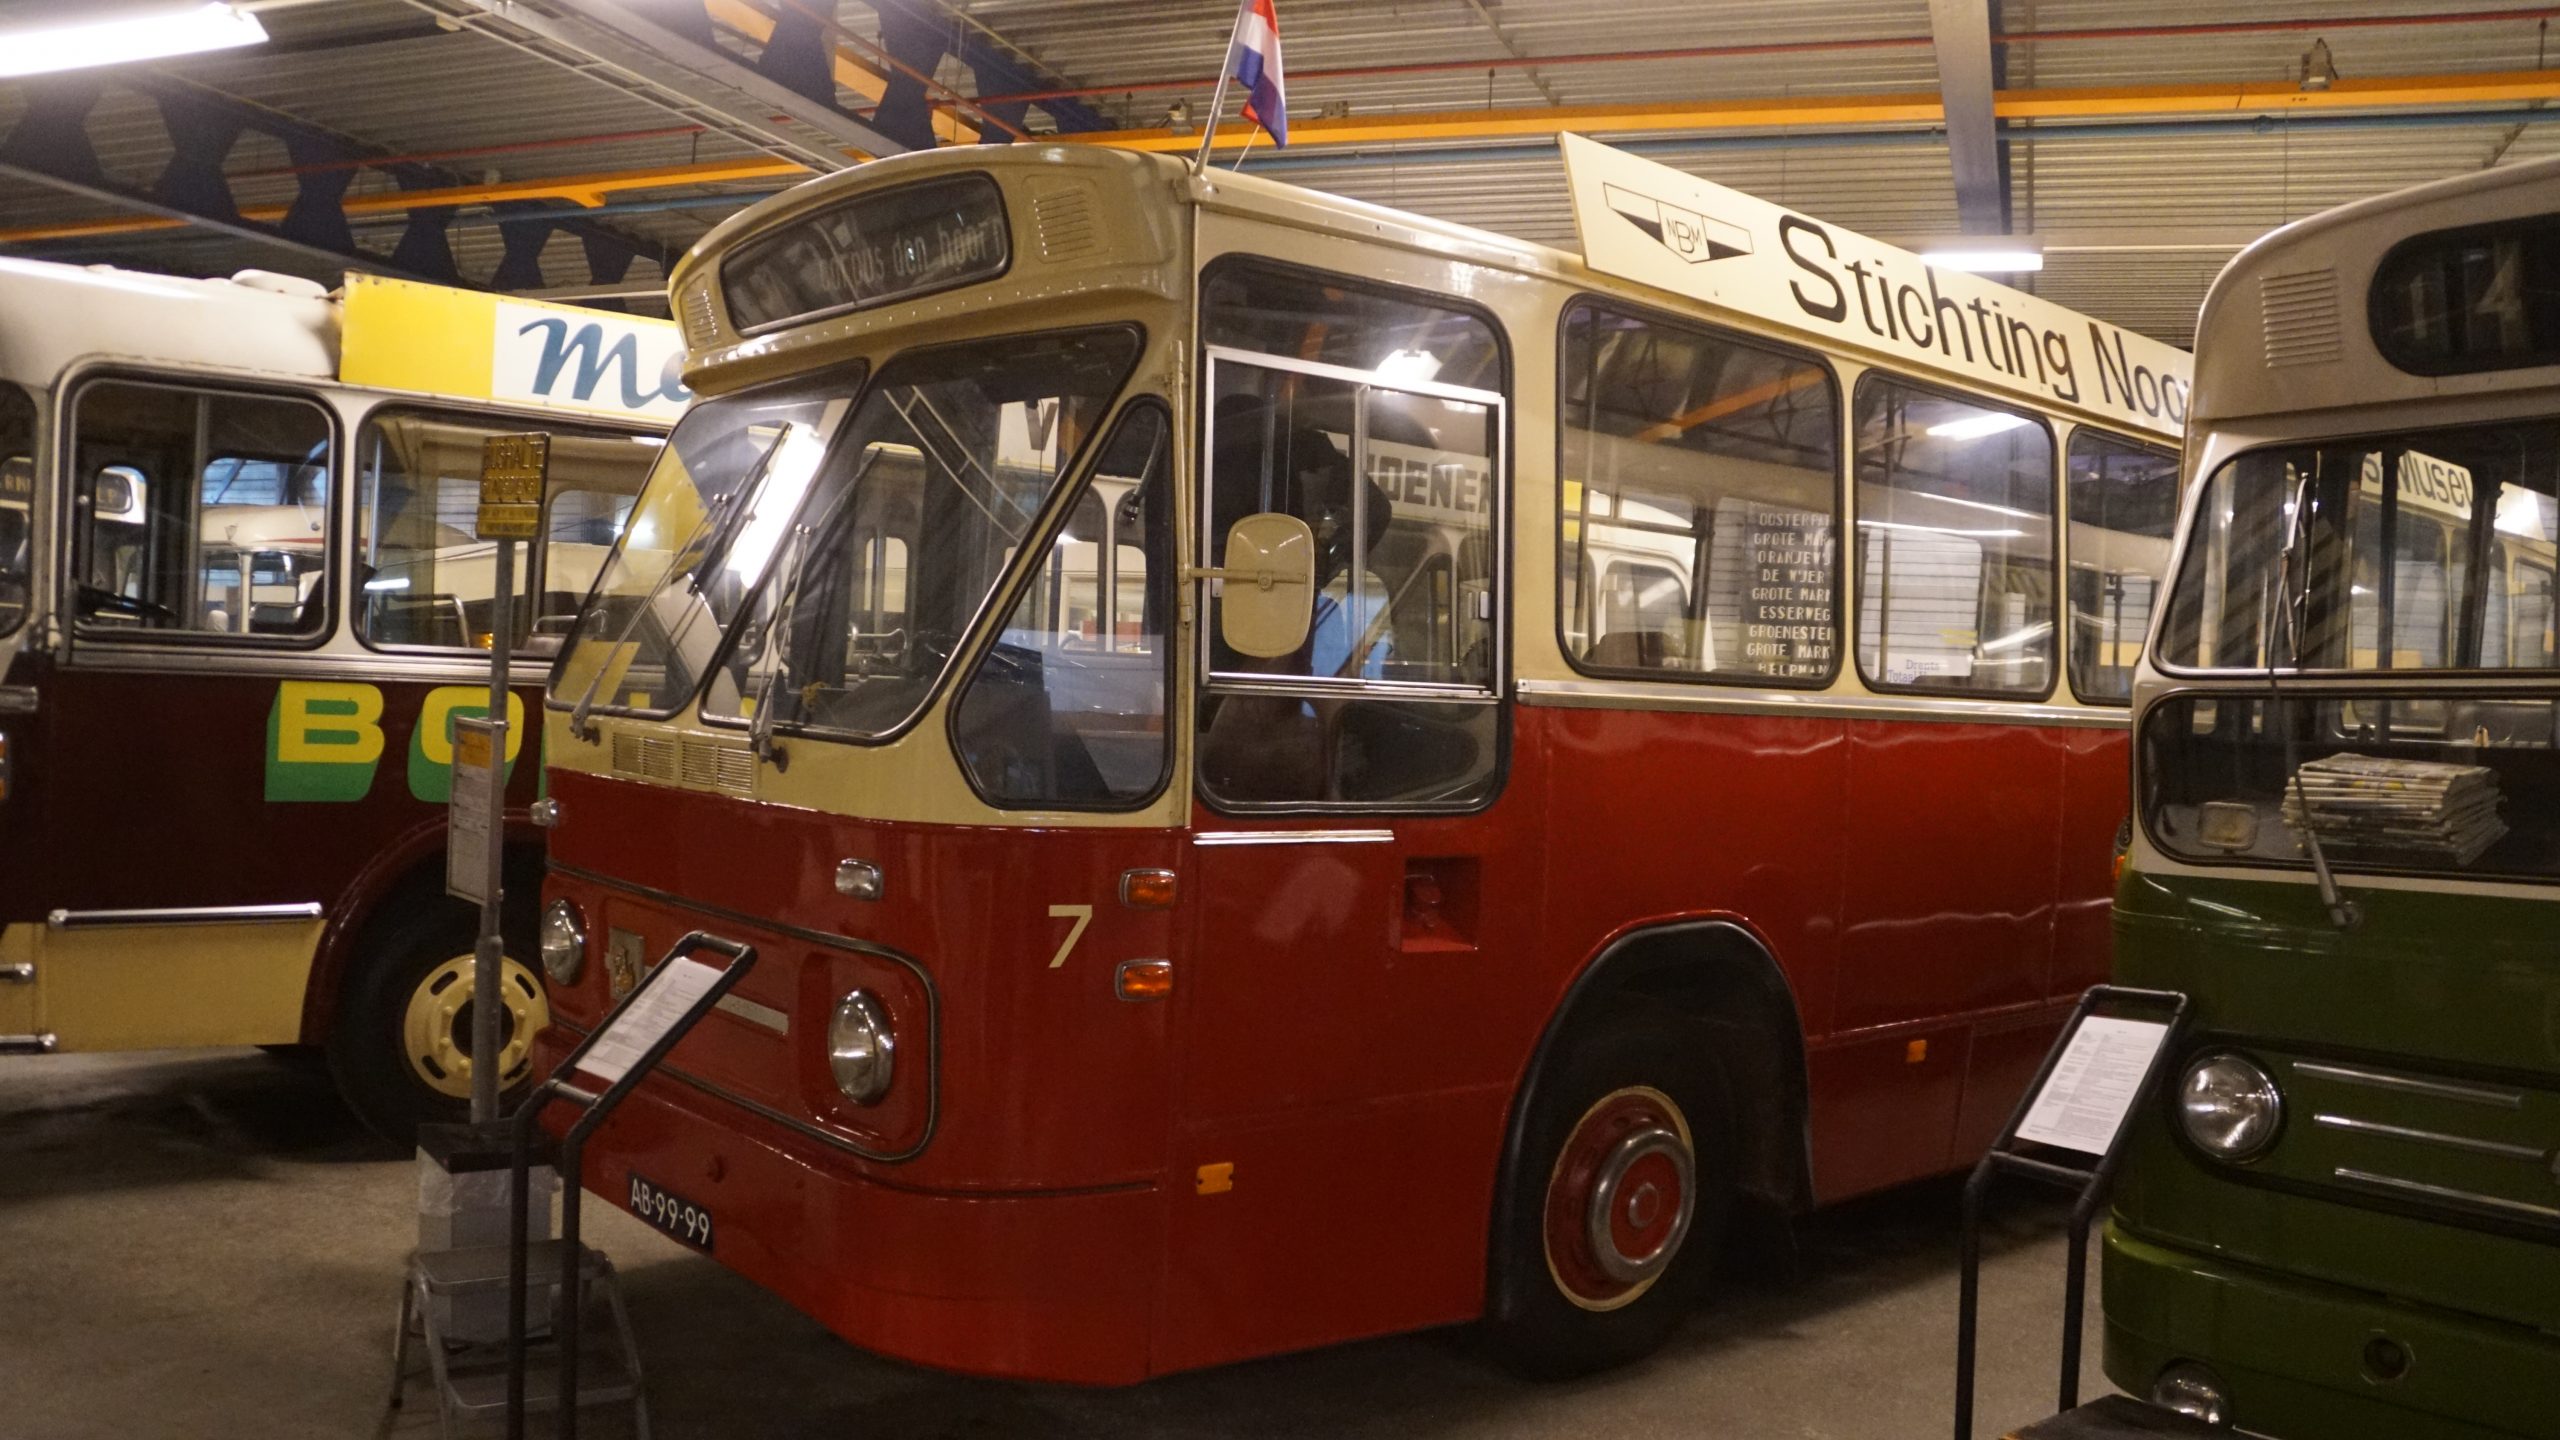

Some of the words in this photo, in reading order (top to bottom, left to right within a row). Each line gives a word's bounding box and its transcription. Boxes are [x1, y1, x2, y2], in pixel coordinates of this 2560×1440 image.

[1666, 217, 1702, 254] NBM
[893, 233, 929, 278] den
[1779, 214, 2080, 404] Stichting
[2087, 321, 2189, 426] Noo
[1753, 532, 1796, 546] GROTE
[1762, 568, 1780, 582] DE
[1752, 587, 1793, 601] GROTE
[1759, 605, 1831, 621] ESSERWEG
[1746, 642, 1787, 656] GROTE
[1048, 904, 1093, 968] 7
[631, 1177, 711, 1246] AB-99-99
